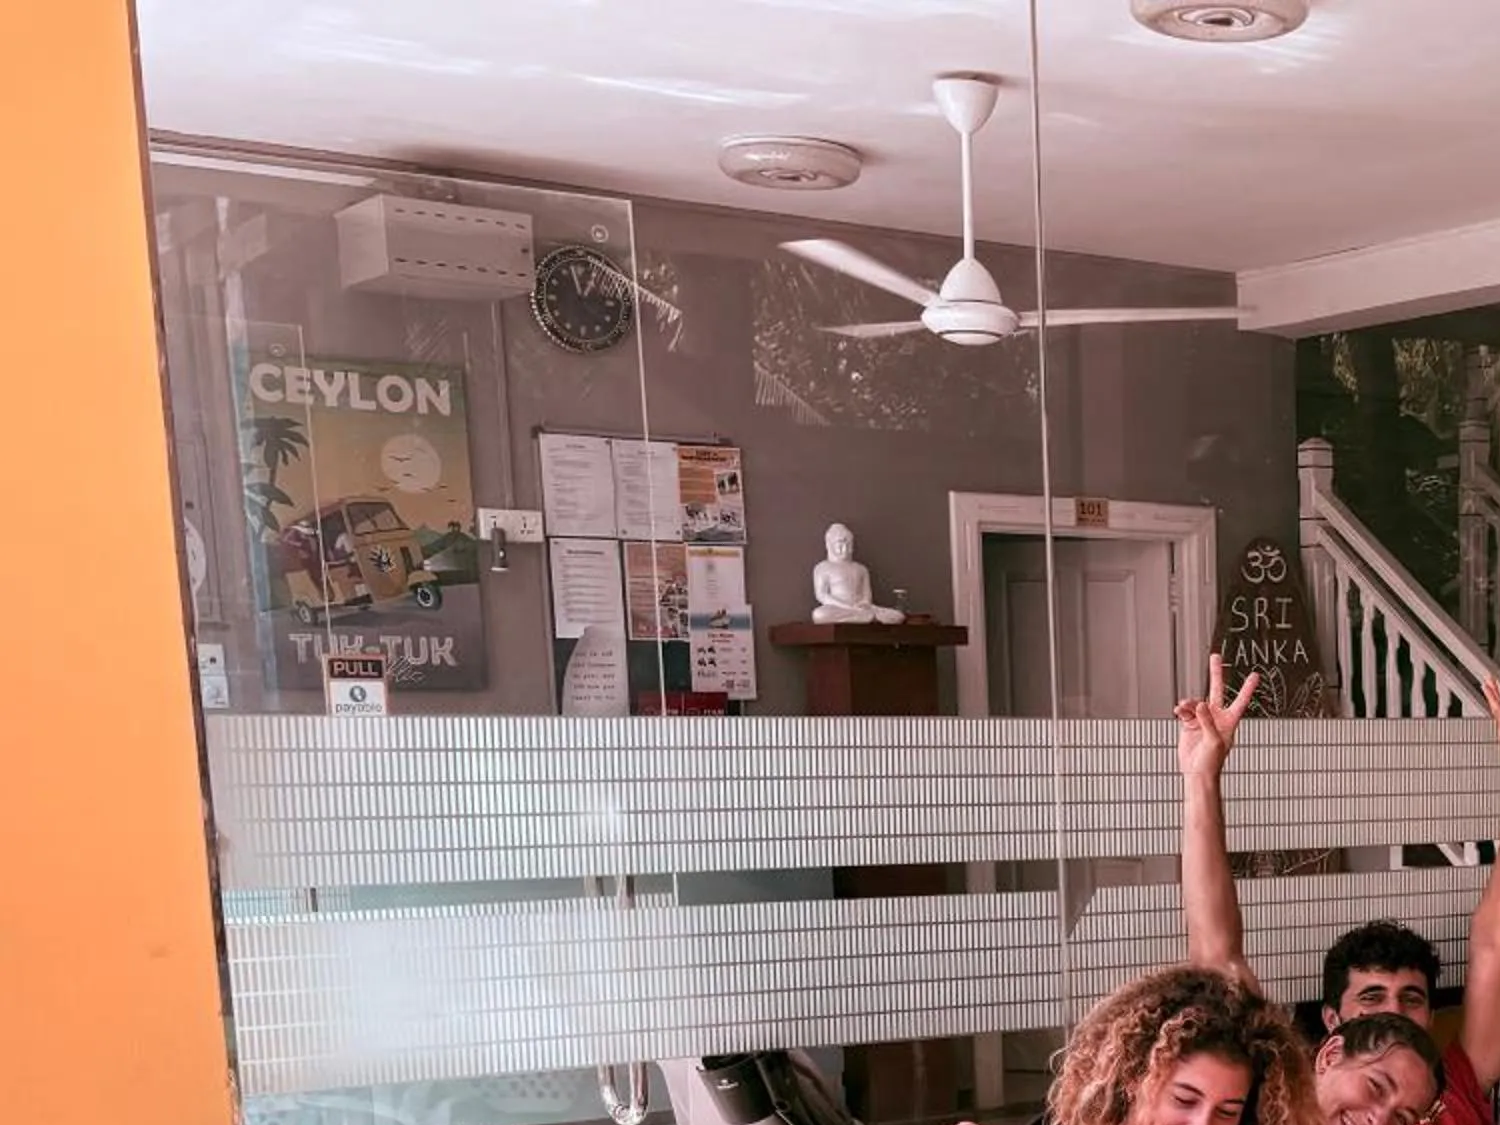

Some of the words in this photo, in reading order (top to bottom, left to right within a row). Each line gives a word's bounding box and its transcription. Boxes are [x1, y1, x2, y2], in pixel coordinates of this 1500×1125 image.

[250, 363, 451, 416] CEYLON
[1229, 596, 1293, 631] SRI
[333, 661, 379, 676] PULL
[1220, 639, 1309, 667] LANKA
